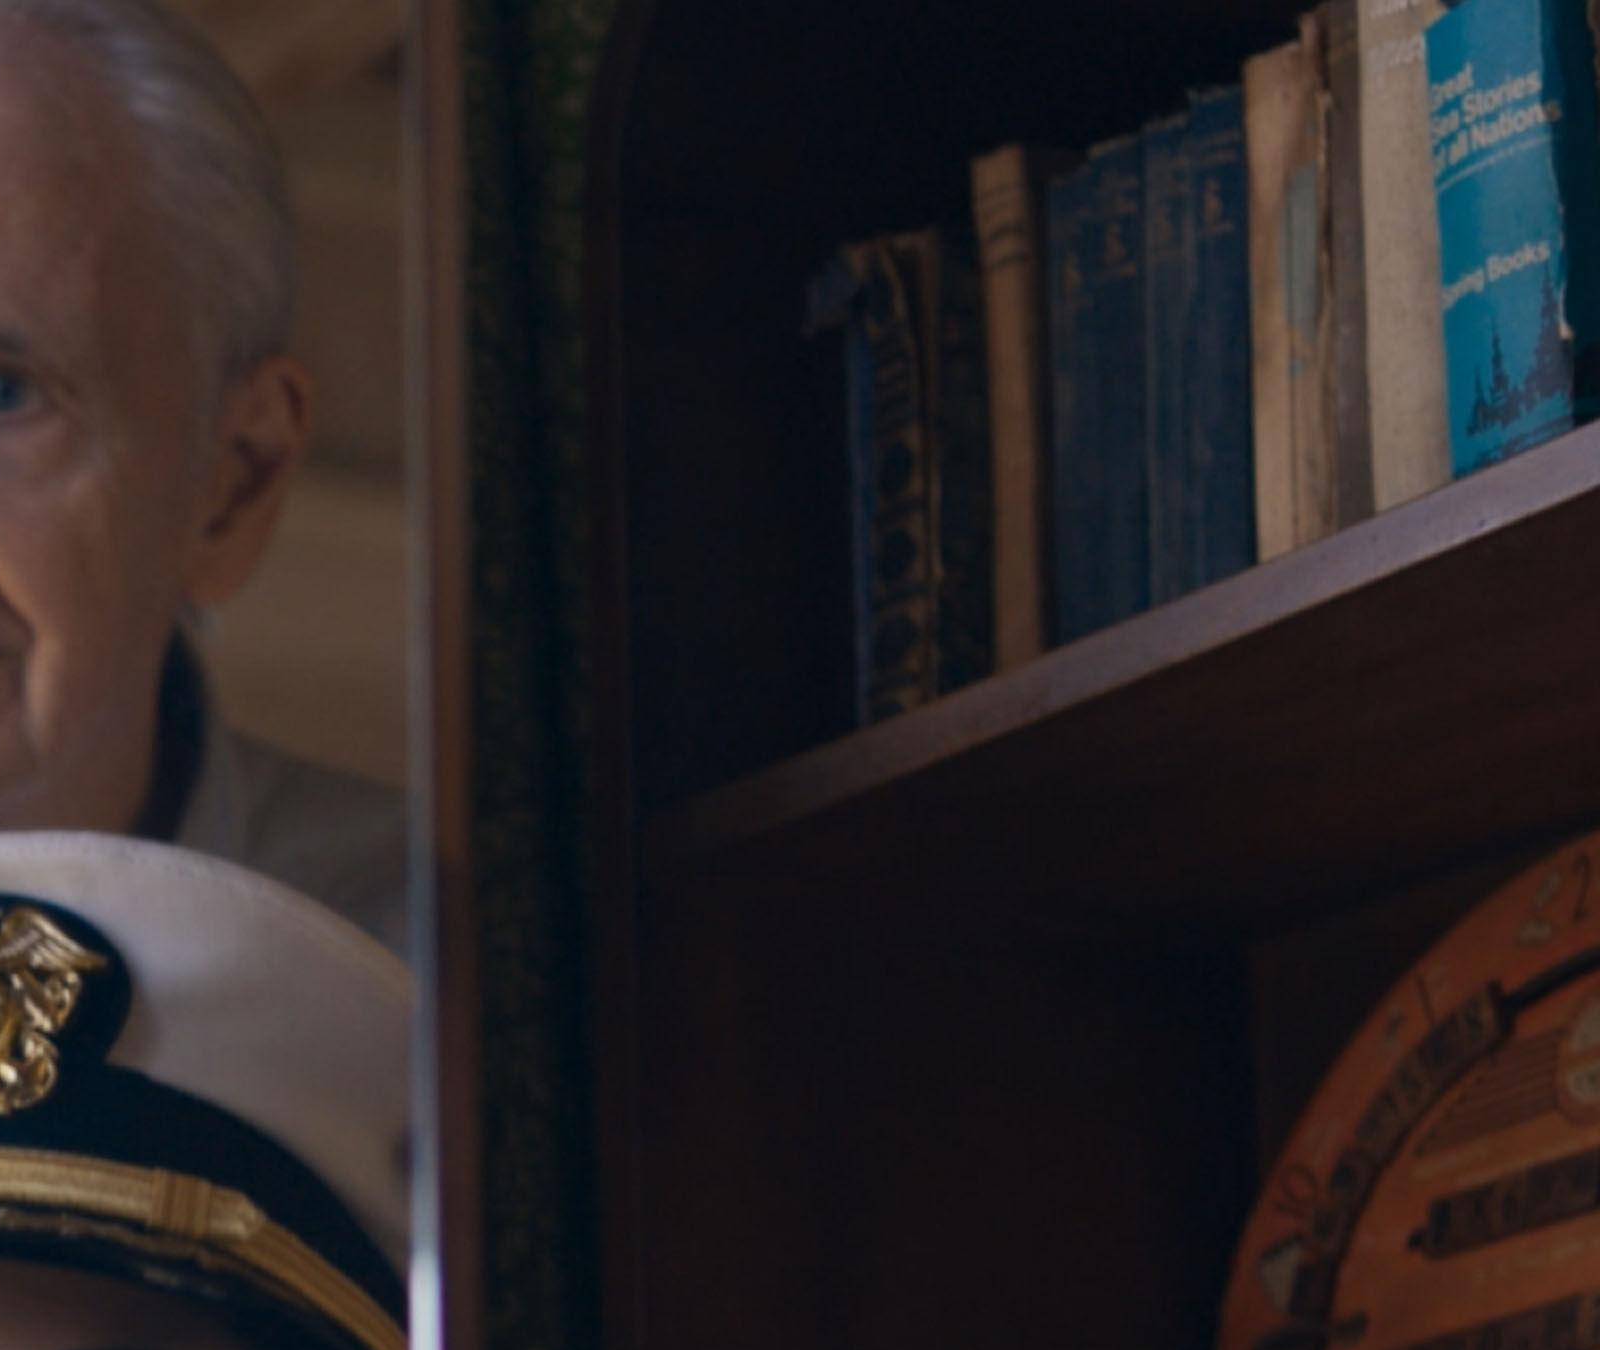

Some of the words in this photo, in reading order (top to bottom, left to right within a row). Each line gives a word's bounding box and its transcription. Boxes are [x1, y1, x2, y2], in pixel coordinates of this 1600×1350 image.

[1462, 69, 1542, 124] Stories
[1471, 99, 1562, 150] Nations
[1486, 240, 1550, 283] Books
